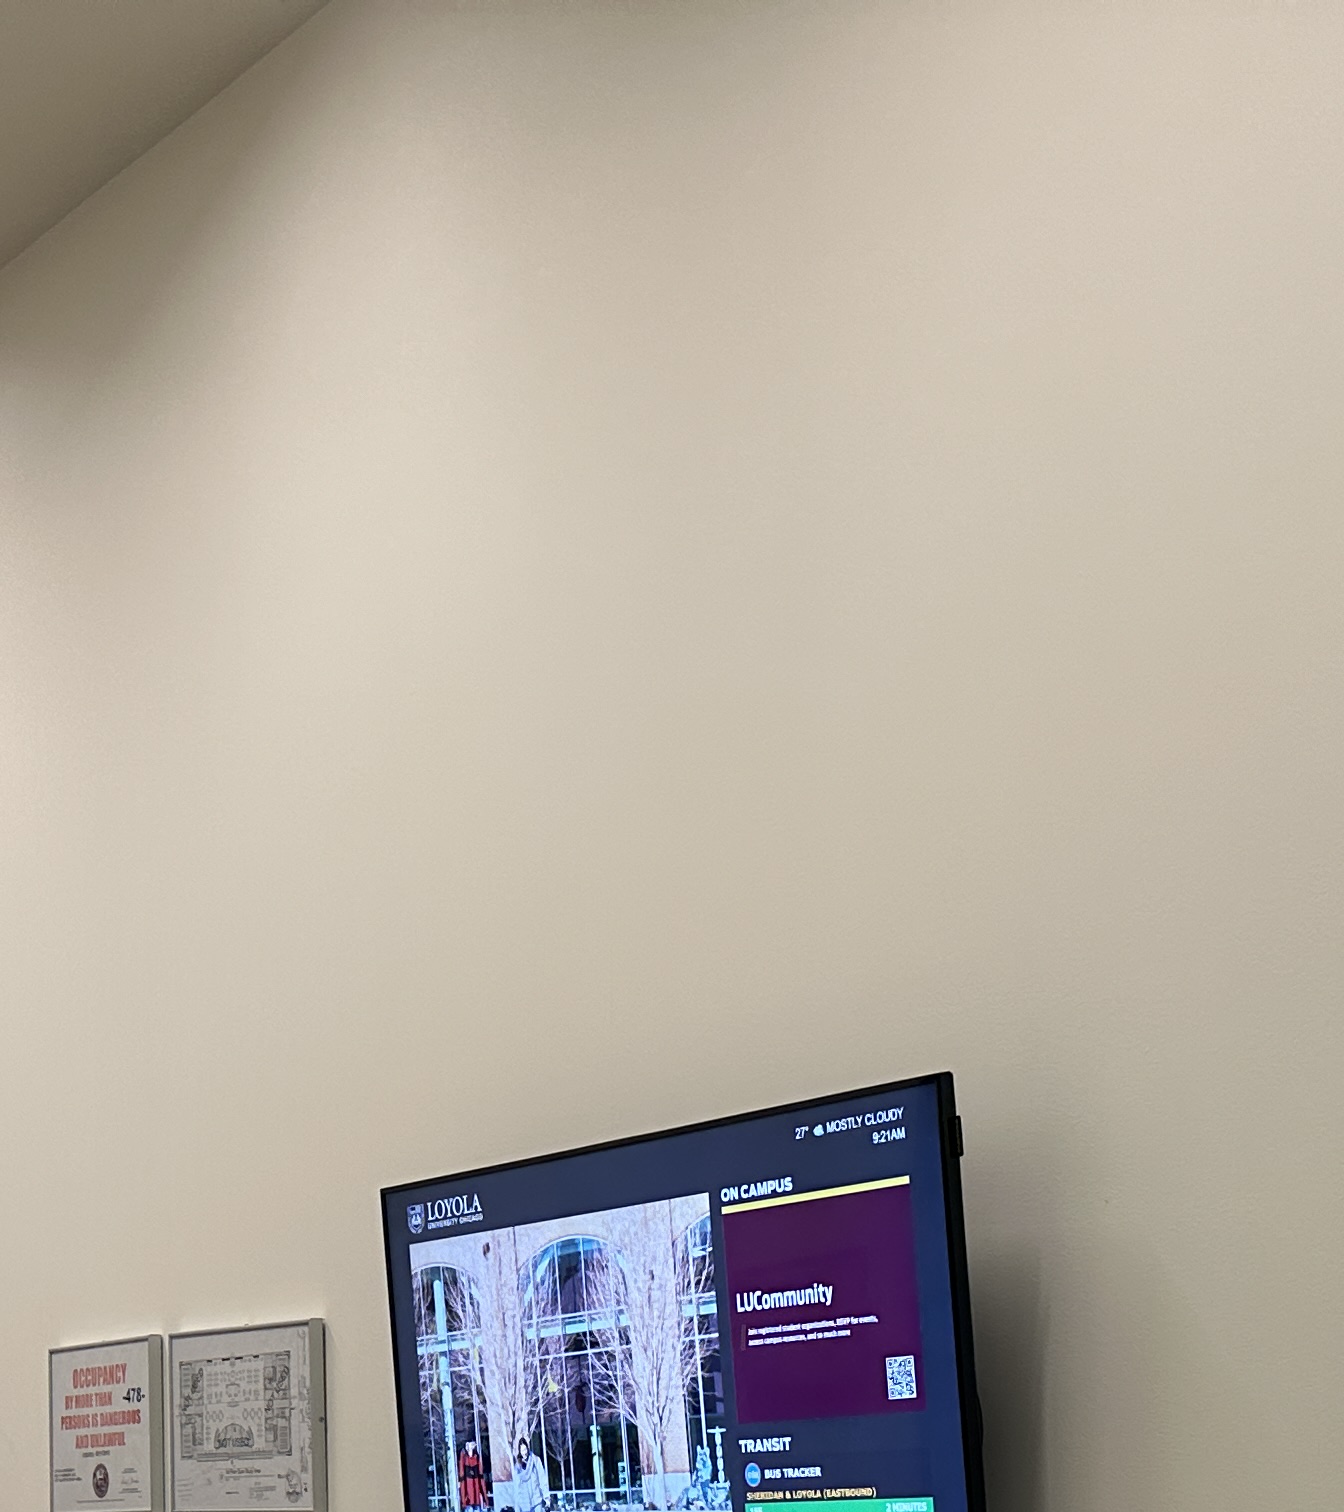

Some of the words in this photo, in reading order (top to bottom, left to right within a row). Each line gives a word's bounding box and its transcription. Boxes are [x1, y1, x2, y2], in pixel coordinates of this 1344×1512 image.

[826, 1115, 863, 1134] MOSTLY
[864, 1106, 904, 1126] CLOUDY
[720, 1186, 739, 1202] ON
[740, 1176, 793, 1199] CAMPUS
[426, 1192, 483, 1221] LOYOLA
[735, 1282, 834, 1313] LUCommunity
[72, 1363, 127, 1389] OCCUPANCY
[64, 1394, 73, 1410] BY
[74, 1392, 94, 1409] MORE
[95, 1391, 113, 1407] THAN
[60, 1414, 91, 1431] PERSONS
[91, 1412, 99, 1428] IS
[99, 1408, 142, 1427] DANGEROUS
[75, 1434, 89, 1449] AND
[90, 1431, 126, 1448] UNLAWFUL
[738, 1436, 792, 1454] TRANSIT
[764, 1468, 782, 1479] BUS
[782, 1466, 822, 1478] TRACKER
[746, 1490, 784, 1501] SHERIDAN
[792, 1489, 823, 1499] LOYOLA
[823, 1486, 877, 1500] (EASTBOUND)
[885, 1503, 892, 1512] 2
[892, 1501, 928, 1512] MINUTES
